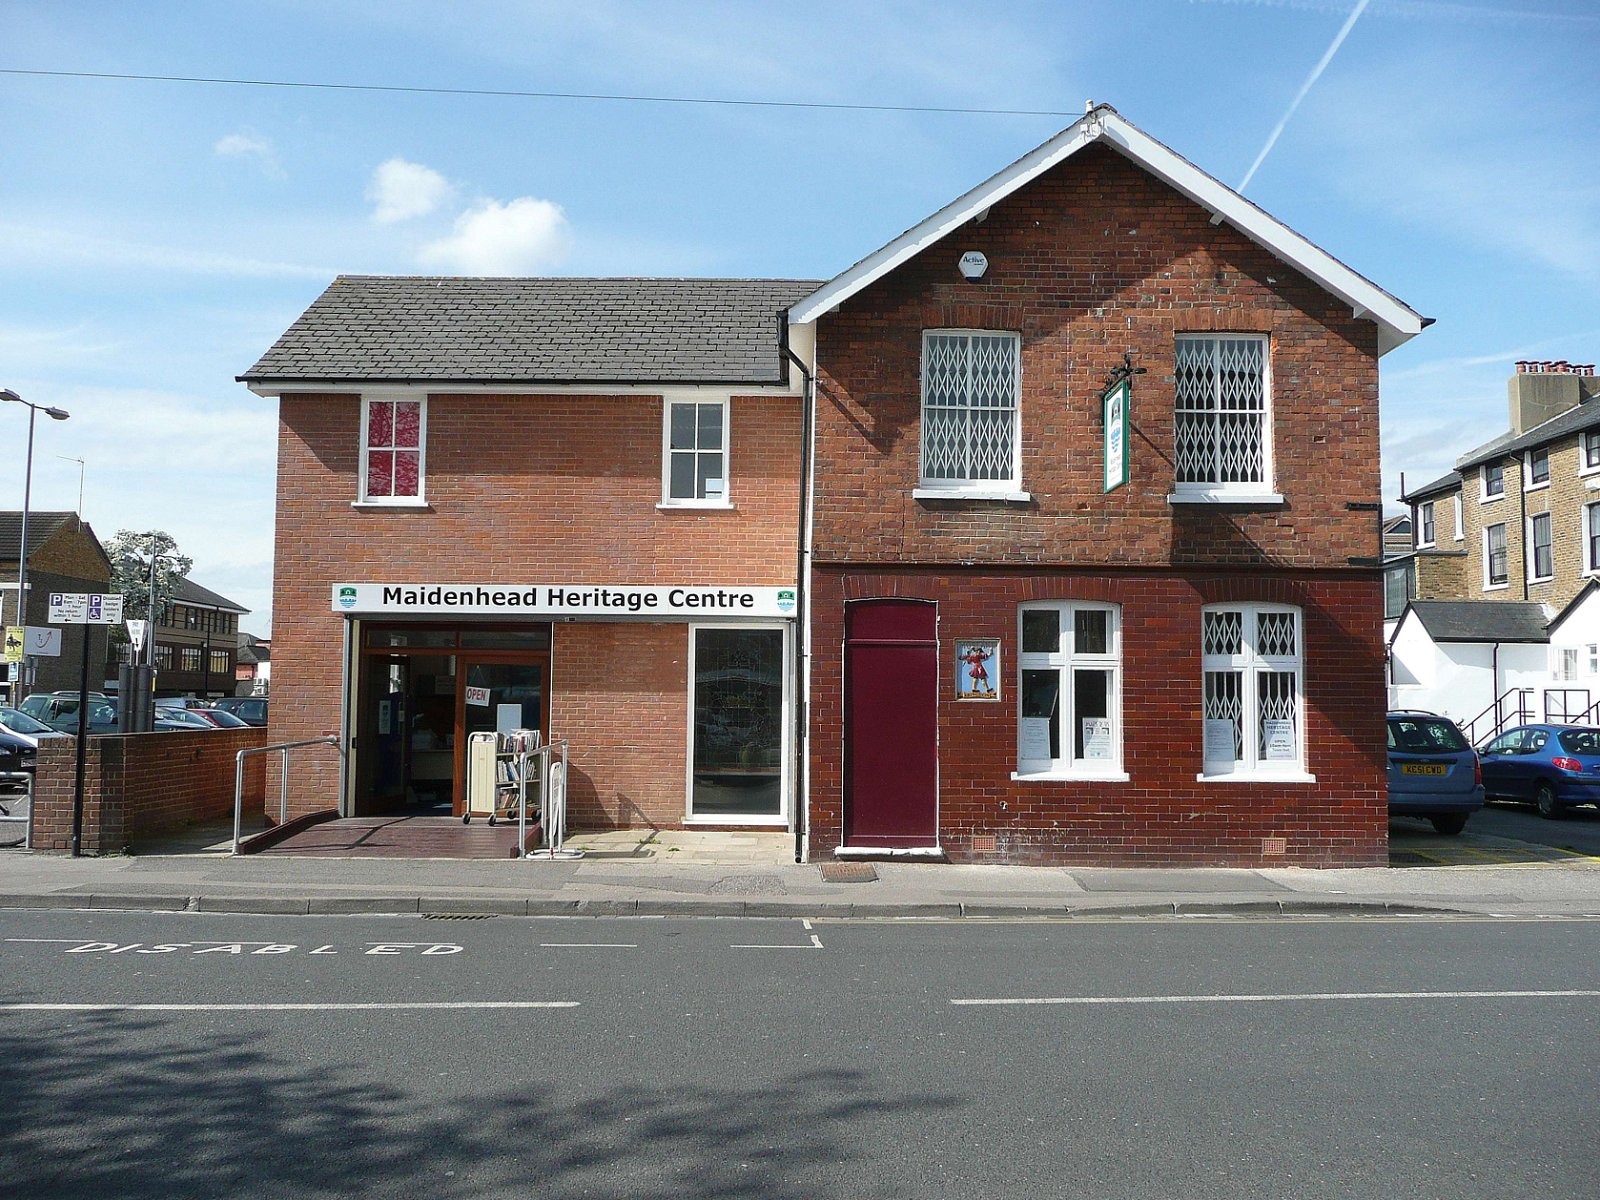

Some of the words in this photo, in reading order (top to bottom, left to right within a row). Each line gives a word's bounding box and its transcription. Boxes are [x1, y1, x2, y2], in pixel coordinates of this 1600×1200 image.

[53, 595, 61, 605] P
[92, 595, 100, 606] P
[383, 587, 537, 606] Maidenhead
[548, 588, 658, 610] Heritage
[668, 589, 754, 608] Centre
[467, 688, 487, 701] OPEN
[64, 942, 464, 955] DISABLED
